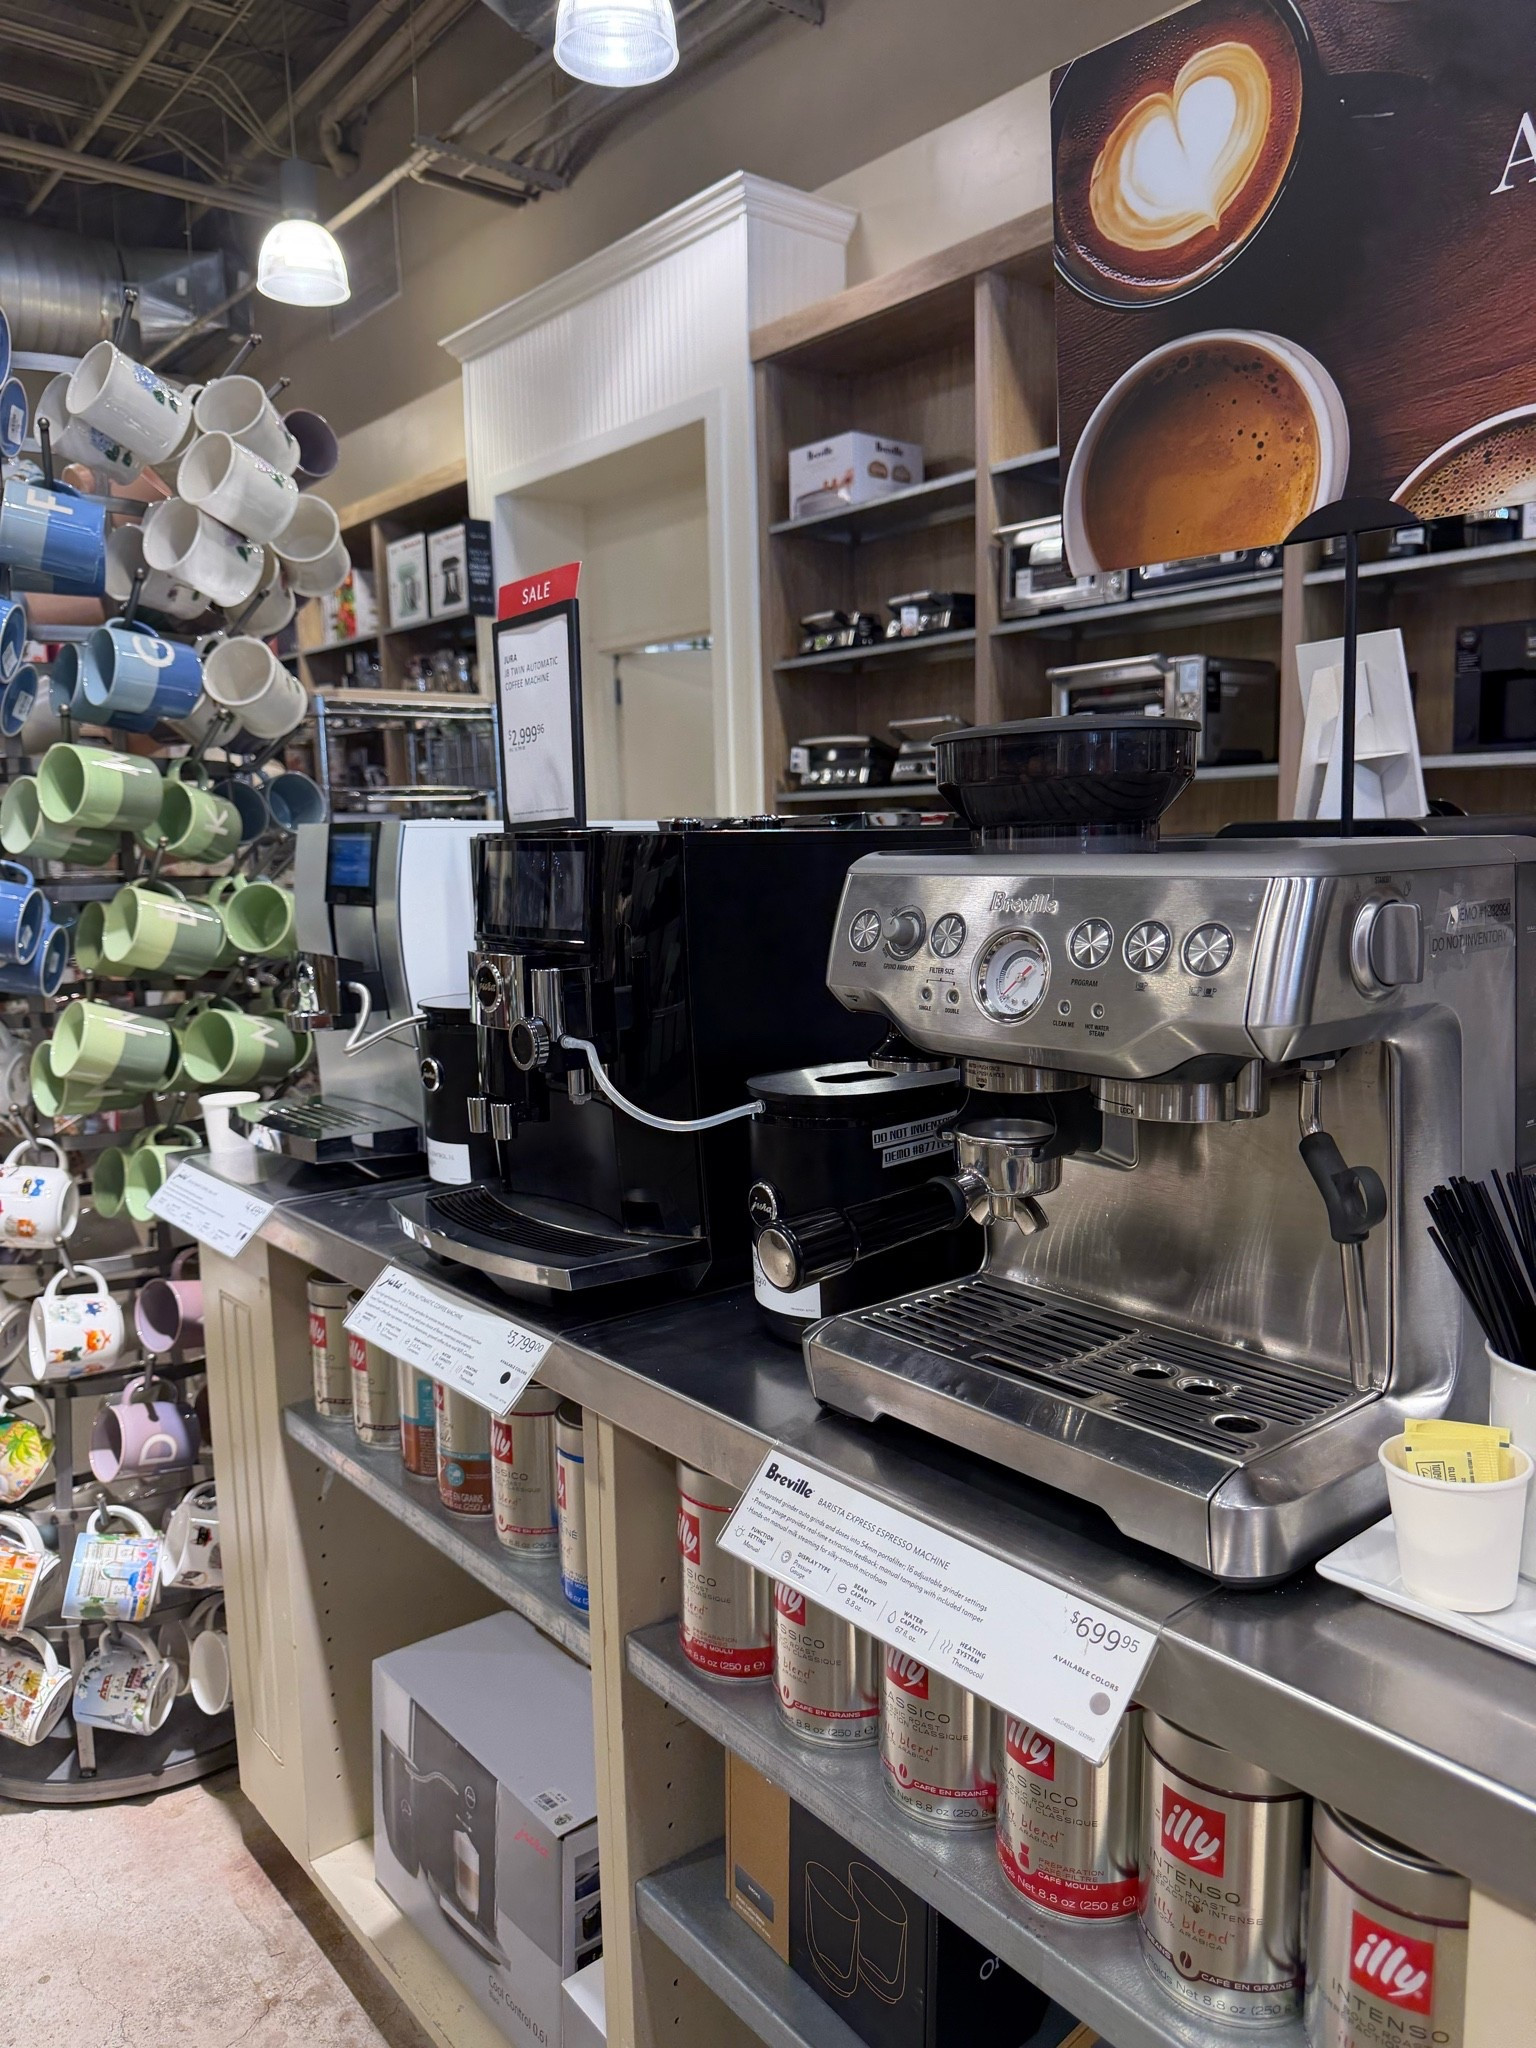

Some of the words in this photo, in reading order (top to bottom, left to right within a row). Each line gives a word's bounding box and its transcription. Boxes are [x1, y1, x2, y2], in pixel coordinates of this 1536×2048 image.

[27, 489, 73, 514] F
[522, 581, 551, 606] SALE
[131, 633, 175, 668] G
[511, 665, 525, 677] TWIN
[526, 656, 558, 672] AUTOMATIC
[505, 678, 524, 691] COFFEE
[524, 672, 550, 687] MACHINE
[204, 805, 229, 836] K
[990, 891, 1059, 915] Breville
[1432, 938, 1445, 952] DO
[1448, 936, 1463, 949] NOT
[1465, 928, 1508, 947] INVENTORY
[852, 960, 866, 968] POWER
[896, 964, 915, 972] AMOUNT
[1070, 978, 1099, 987] PROGRAM
[1085, 1023, 1093, 1031] HOT
[1120, 1106, 1135, 1116] LOCK
[874, 1132, 887, 1144] DO
[890, 1127, 908, 1140] NOT
[885, 1148, 911, 1162] DEMO
[433, 1302, 448, 1312] COFFEE
[138, 1433, 177, 1466] D
[765, 1463, 812, 1498] Breville
[747, 1532, 766, 1546] SETTING
[750, 1526, 774, 1542] FUNCTION
[817, 1497, 845, 1517] BARISTA
[845, 1512, 876, 1532] EXPRESS
[875, 1527, 913, 1551] ESPRESSO
[912, 1546, 950, 1570] MACHINE
[742, 1539, 760, 1553] Manual
[748, 1506, 770, 1522] Hands-on
[769, 1519, 789, 1532] manual
[787, 1529, 798, 1537] milk
[797, 1534, 820, 1551] steaming
[819, 1544, 828, 1553] for
[827, 1550, 859, 1571] silky-smooth
[858, 1568, 887, 1586] microfoam
[758, 1488, 783, 1504] Integrated
[780, 1501, 799, 1512] grinder
[798, 1510, 810, 1519] auto
[809, 1516, 825, 1527] grinds
[824, 1524, 837, 1532] and
[835, 1528, 850, 1540] doses
[849, 1535, 860, 1546] into
[859, 1540, 878, 1554] 54mm
[876, 1551, 906, 1570] portafilter;
[906, 1564, 915, 1573] 16
[913, 1570, 943, 1589] adjustable
[942, 1585, 964, 1599] grinder
[964, 1596, 987, 1612] settings
[753, 1497, 772, 1511] Pressure
[771, 1508, 787, 1519] gauge
[785, 1516, 806, 1530] provides
[806, 1526, 828, 1541] real-time
[827, 1538, 853, 1555] extraction
[853, 1549, 879, 1569] feedback;
[878, 1565, 901, 1579] manual
[899, 1575, 923, 1593] tamping
[923, 1589, 936, 1599] with
[936, 1594, 962, 1612] included
[961, 1608, 983, 1623] tamper
[792, 1559, 812, 1574] Pressure
[797, 1552, 818, 1566] DISPLAY
[817, 1562, 831, 1574] TYPE
[789, 1566, 805, 1579] Gauge
[850, 1589, 877, 1607] CAPACITY
[853, 1583, 868, 1594] BEAN
[844, 1598, 856, 1608] 8.8
[899, 1617, 928, 1635] CAPACITY
[903, 1610, 923, 1625] WATER
[894, 1625, 904, 1634] 67
[956, 1648, 980, 1664] SYSTEM
[959, 1641, 986, 1659] HEATING
[707, 1659, 718, 1668] oz
[720, 1661, 742, 1671] (250
[951, 1656, 984, 1680] Thermocoil
[1052, 1654, 1090, 1677] AVAILABLE
[1090, 1673, 1119, 1692] COLORS
[815, 1708, 827, 1717] EN
[829, 1710, 861, 1719] GRAINS
[796, 1718, 811, 1732] 8.8
[813, 1725, 825, 1735] oz
[827, 1727, 852, 1737] (250
[854, 1729, 861, 1738] g
[909, 1717, 940, 1732] ROAST
[912, 1724, 969, 1741] CLASSIQUE
[900, 1731, 934, 1757] blend
[1008, 1720, 1051, 1765] illy
[954, 1789, 988, 1797] GRAINS
[915, 1801, 933, 1814] 8.8
[936, 1809, 949, 1817] oz
[952, 1809, 978, 1818] (250
[1031, 1796, 1066, 1816] ROAST
[1035, 1806, 1098, 1828] CLASSIQUE
[1019, 1826, 1055, 1849] ARABICA
[1021, 1813, 1059, 1843] blend
[1164, 1804, 1221, 1862] illy
[514, 1822, 550, 1859] jura
[1017, 1875, 1035, 1894] Net
[1038, 1889, 1058, 1904] 8.8
[1061, 1899, 1076, 1909] oz
[1079, 1900, 1108, 1911] (250
[1111, 1902, 1119, 1912] g
[1064, 1881, 1099, 1891] MOULU
[1185, 1890, 1226, 1911] ROAST
[1154, 1892, 1173, 1919] illy
[1182, 1915, 1228, 1945] blend
[1208, 1909, 1264, 1926] INTENSE
[1178, 1929, 1223, 1952] ARABICA
[1354, 1933, 1427, 1997] illy
[1201, 1972, 1230, 1988] CAFÉ
[1234, 1982, 1250, 1991] EN
[1253, 1981, 1293, 1992] GRAINS
[488, 1974, 504, 2000] Cool
[505, 1995, 531, 2029] Control
[1176, 1980, 1199, 2001] Net
[1202, 1995, 1225, 2011] 8.8
[1230, 2005, 1246, 2015] oz
[1251, 2005, 1280, 2016] (250
[1332, 1978, 1450, 2044] INTENSO
